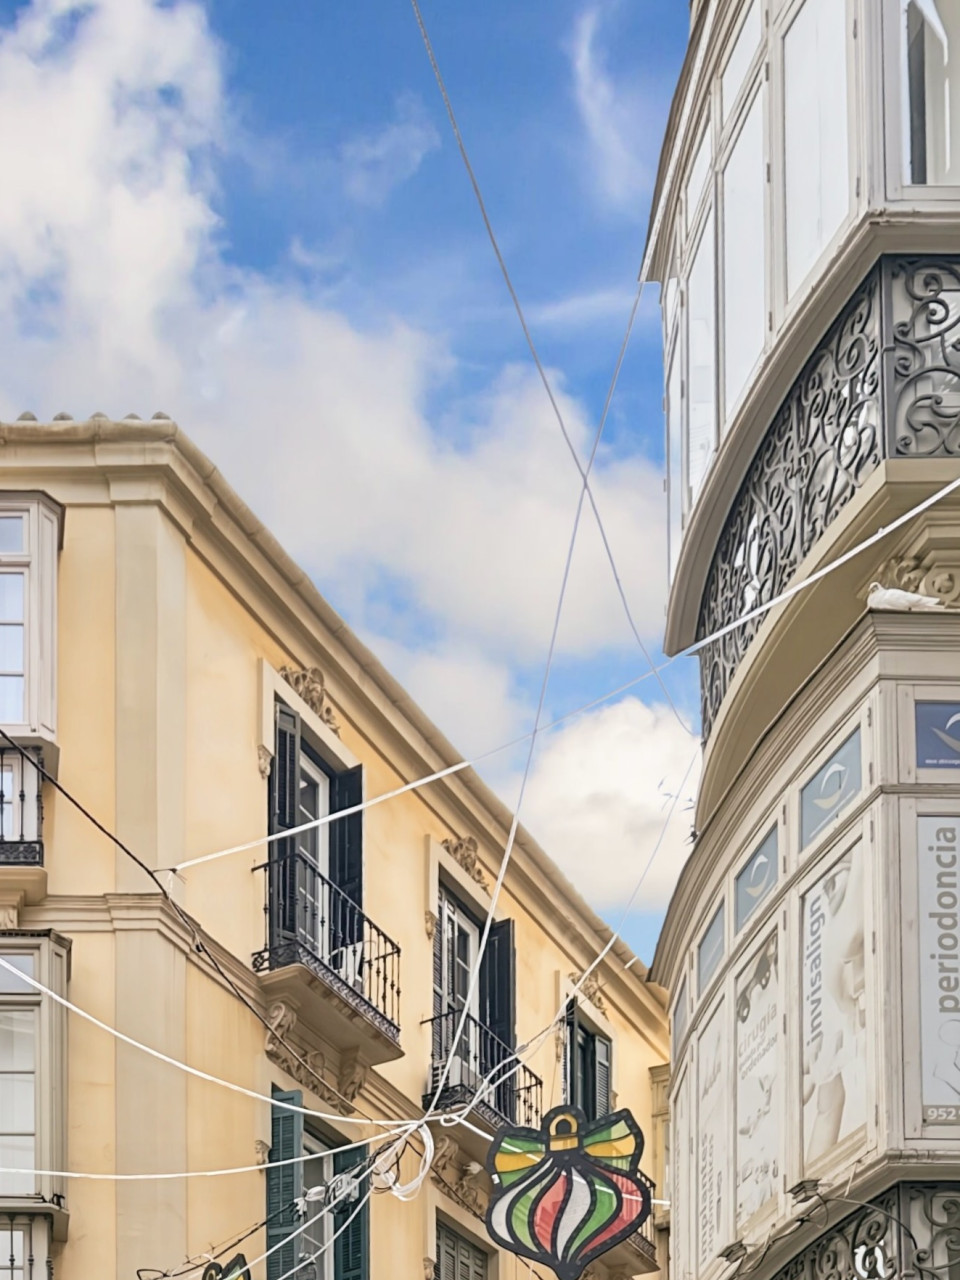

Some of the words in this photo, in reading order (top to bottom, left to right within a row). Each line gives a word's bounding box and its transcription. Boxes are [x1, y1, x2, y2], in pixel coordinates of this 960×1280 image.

[805, 895, 826, 1048] invisalign
[928, 826, 960, 1014] periodoncia
[928, 1108, 957, 1120] 952
